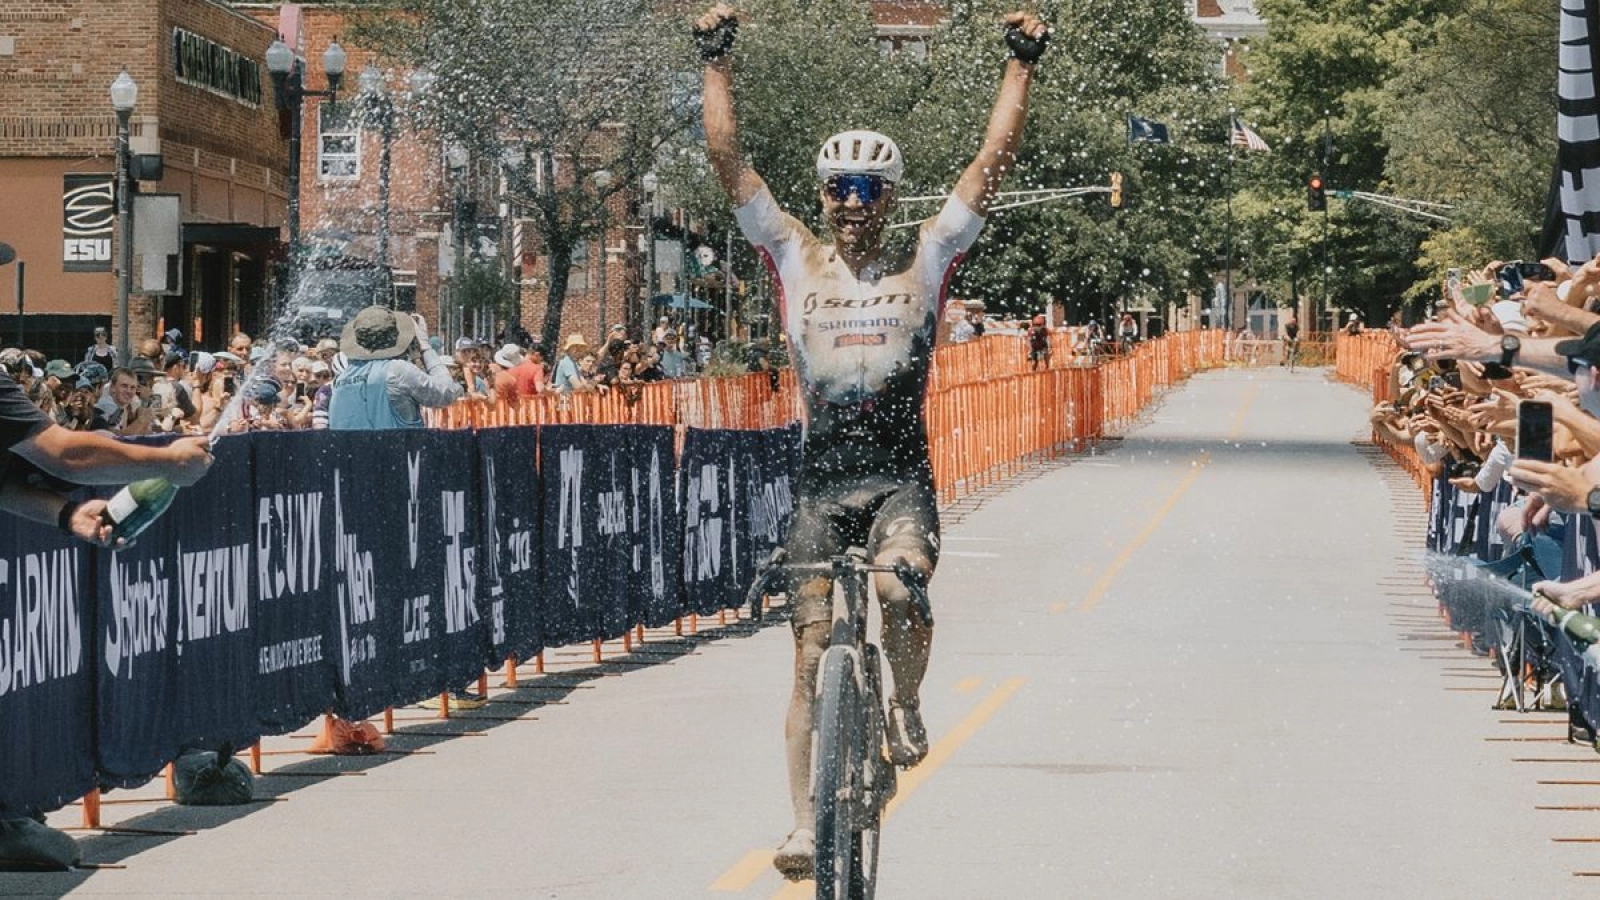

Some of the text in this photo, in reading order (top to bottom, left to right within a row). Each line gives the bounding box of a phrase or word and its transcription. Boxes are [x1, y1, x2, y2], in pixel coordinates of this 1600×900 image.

[64, 239, 111, 261] ESU
[821, 294, 914, 309] SCOTT
[818, 317, 900, 332] SHIMANO
[0, 547, 82, 696] GARMIN
